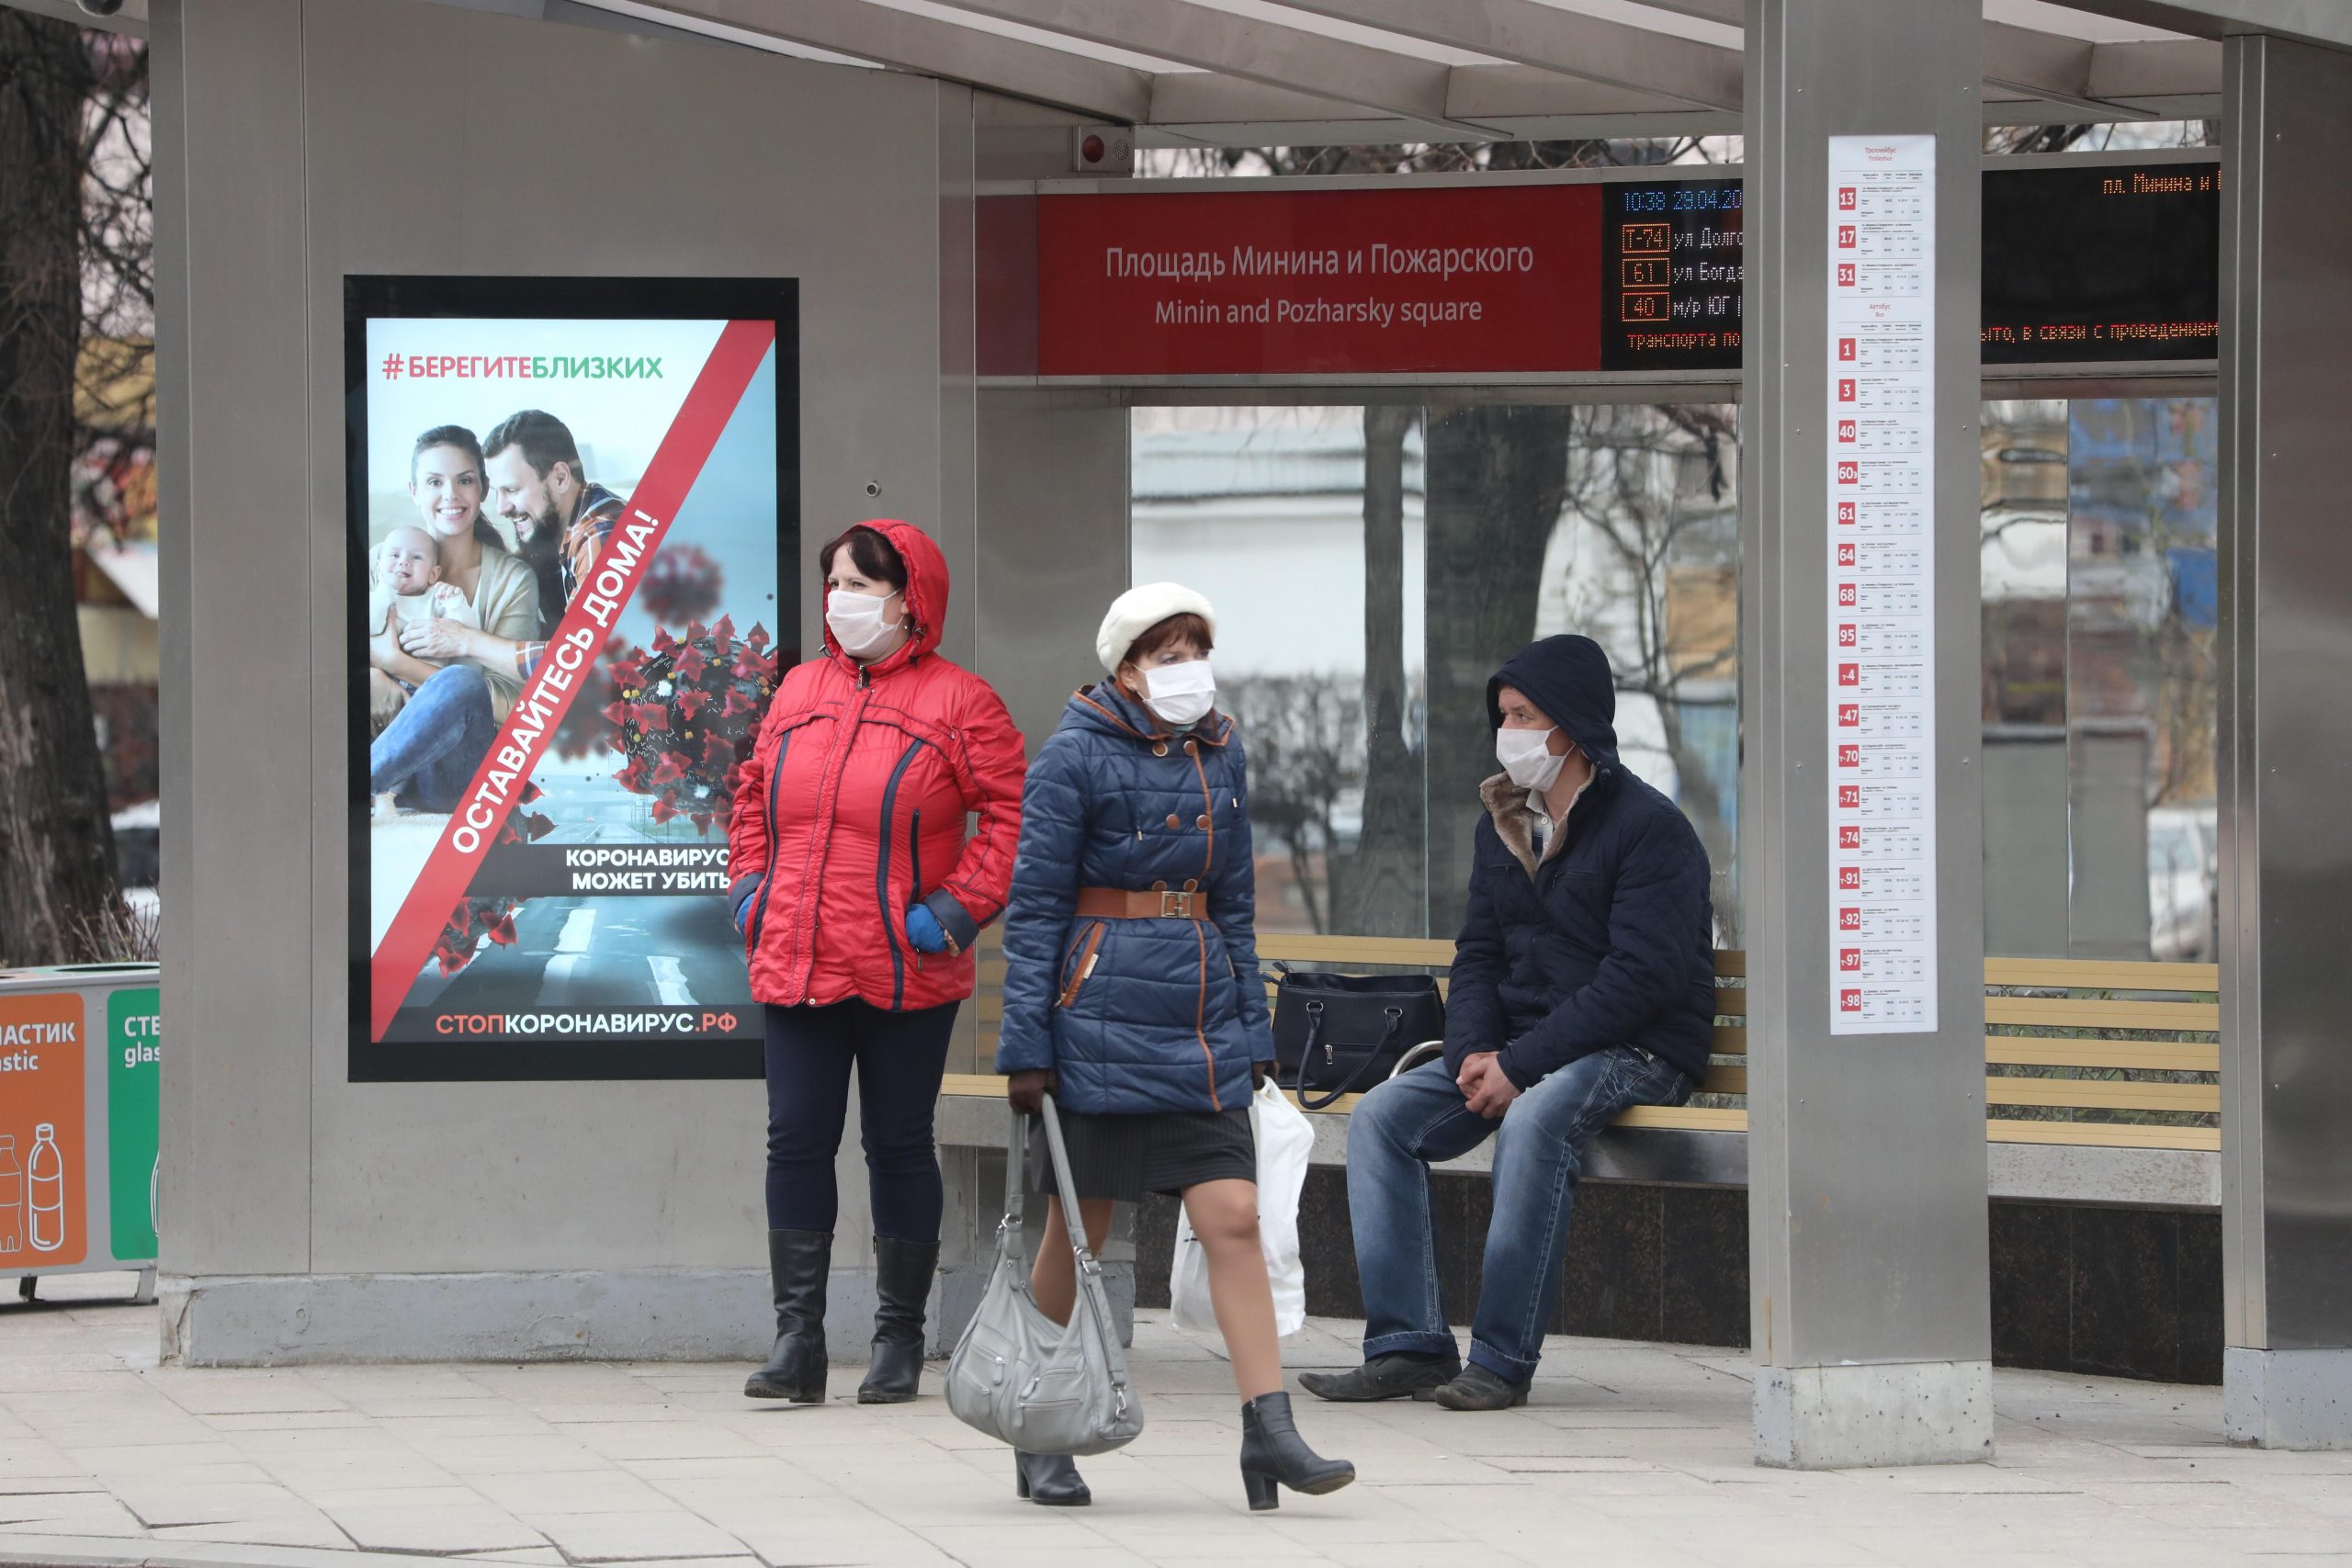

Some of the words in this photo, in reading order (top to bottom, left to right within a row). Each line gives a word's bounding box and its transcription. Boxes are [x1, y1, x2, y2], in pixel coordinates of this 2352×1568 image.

[2103, 178, 2126, 195] пл.
[2133, 173, 2192, 194] Минина
[2199, 175, 2210, 191] и
[1624, 191, 1666, 211] 10:38
[1839, 192, 1855, 206] 13
[1625, 228, 1663, 249] Т-74
[1674, 233, 1693, 250] ул
[1839, 230, 1855, 244] 17
[1105, 246, 1226, 282] Площадь
[1232, 245, 1340, 276] Минина
[1346, 250, 1363, 274] и
[1371, 243, 1534, 280] Пожарского
[1634, 263, 1653, 282] 61
[1674, 267, 1693, 284] ул
[1839, 268, 1854, 282] 31
[1155, 299, 1220, 324] Minin
[1227, 299, 1270, 323] and
[1276, 298, 1395, 328] Pozharsky
[1400, 300, 1483, 328] square
[1634, 297, 1655, 317] 40
[1673, 297, 1702, 319] м/р
[1708, 296, 1731, 315] ЮГ
[2023, 324, 2032, 341] в
[2040, 324, 2086, 341] связи
[2094, 324, 2103, 339] с
[2110, 321, 2219, 342] проведением
[1627, 333, 1716, 351] транспорта
[1843, 344, 1851, 356] 1
[382, 353, 663, 380] #БЕРЕГИТЕБЛИЗКИХ
[1843, 384, 1851, 397] 3
[1839, 425, 1855, 438] 40
[1839, 507, 1854, 520] 61
[1839, 548, 1854, 561] 64
[1839, 589, 1855, 602] 68
[1839, 628, 1855, 642] 95
[452, 626, 594, 853] ОСТАВАЙТЕСЬ
[582, 510, 660, 628] ДОМА!
[566, 849, 730, 867] КОРОНАВИРУС
[572, 872, 656, 890] МОЖЕТ
[661, 872, 731, 889] УБИТЬ
[435, 1010, 738, 1034] СТОПКОРОНАВИРУС.РФ
[0, 1049, 39, 1072] stic
